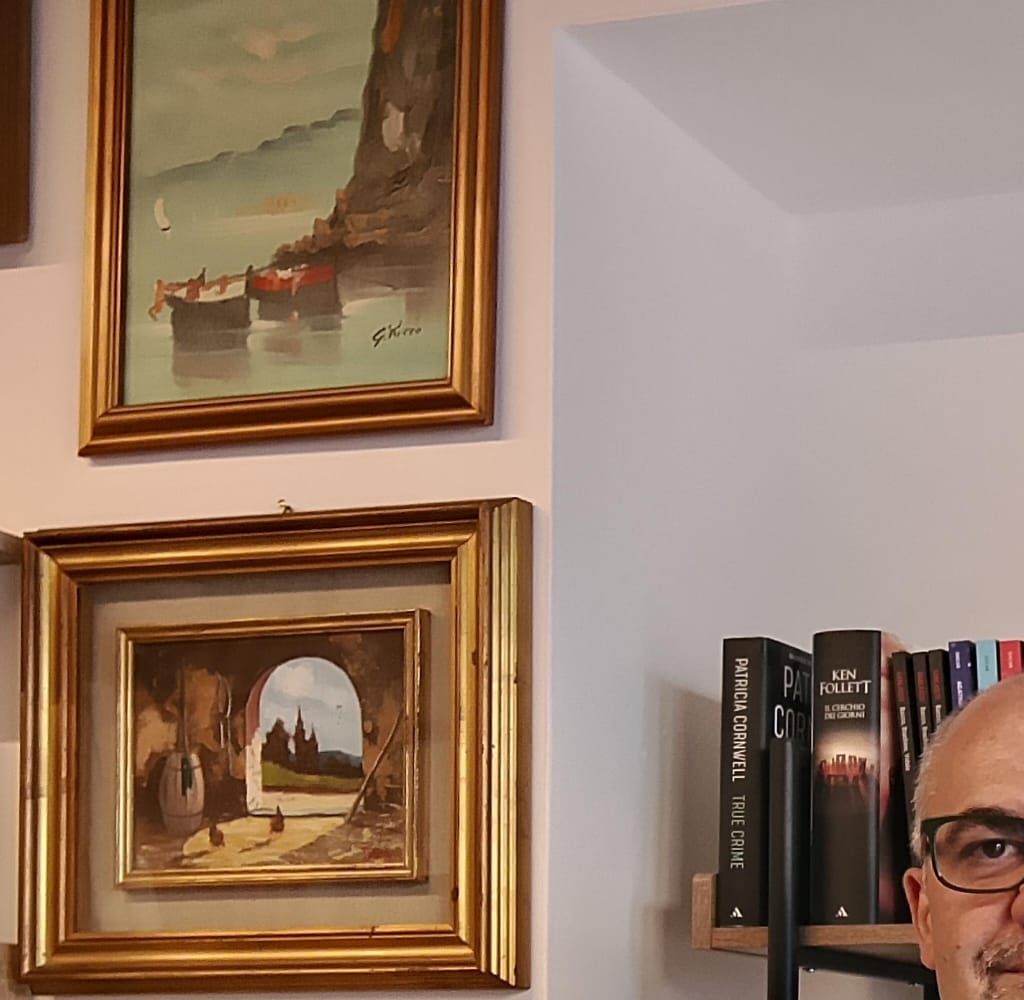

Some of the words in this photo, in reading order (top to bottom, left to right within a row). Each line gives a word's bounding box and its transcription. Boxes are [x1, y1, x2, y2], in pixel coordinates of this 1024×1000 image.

[733, 657, 749, 712] PATRICIA
[832, 668, 856, 681] KEN
[819, 680, 872, 696] FOLLETT
[831, 703, 866, 712] CERCHIO
[837, 711, 865, 720] GIORNI
[732, 715, 747, 782] CORNWELL
[731, 795, 746, 826] TRUE
[730, 830, 744, 869] CRIME
